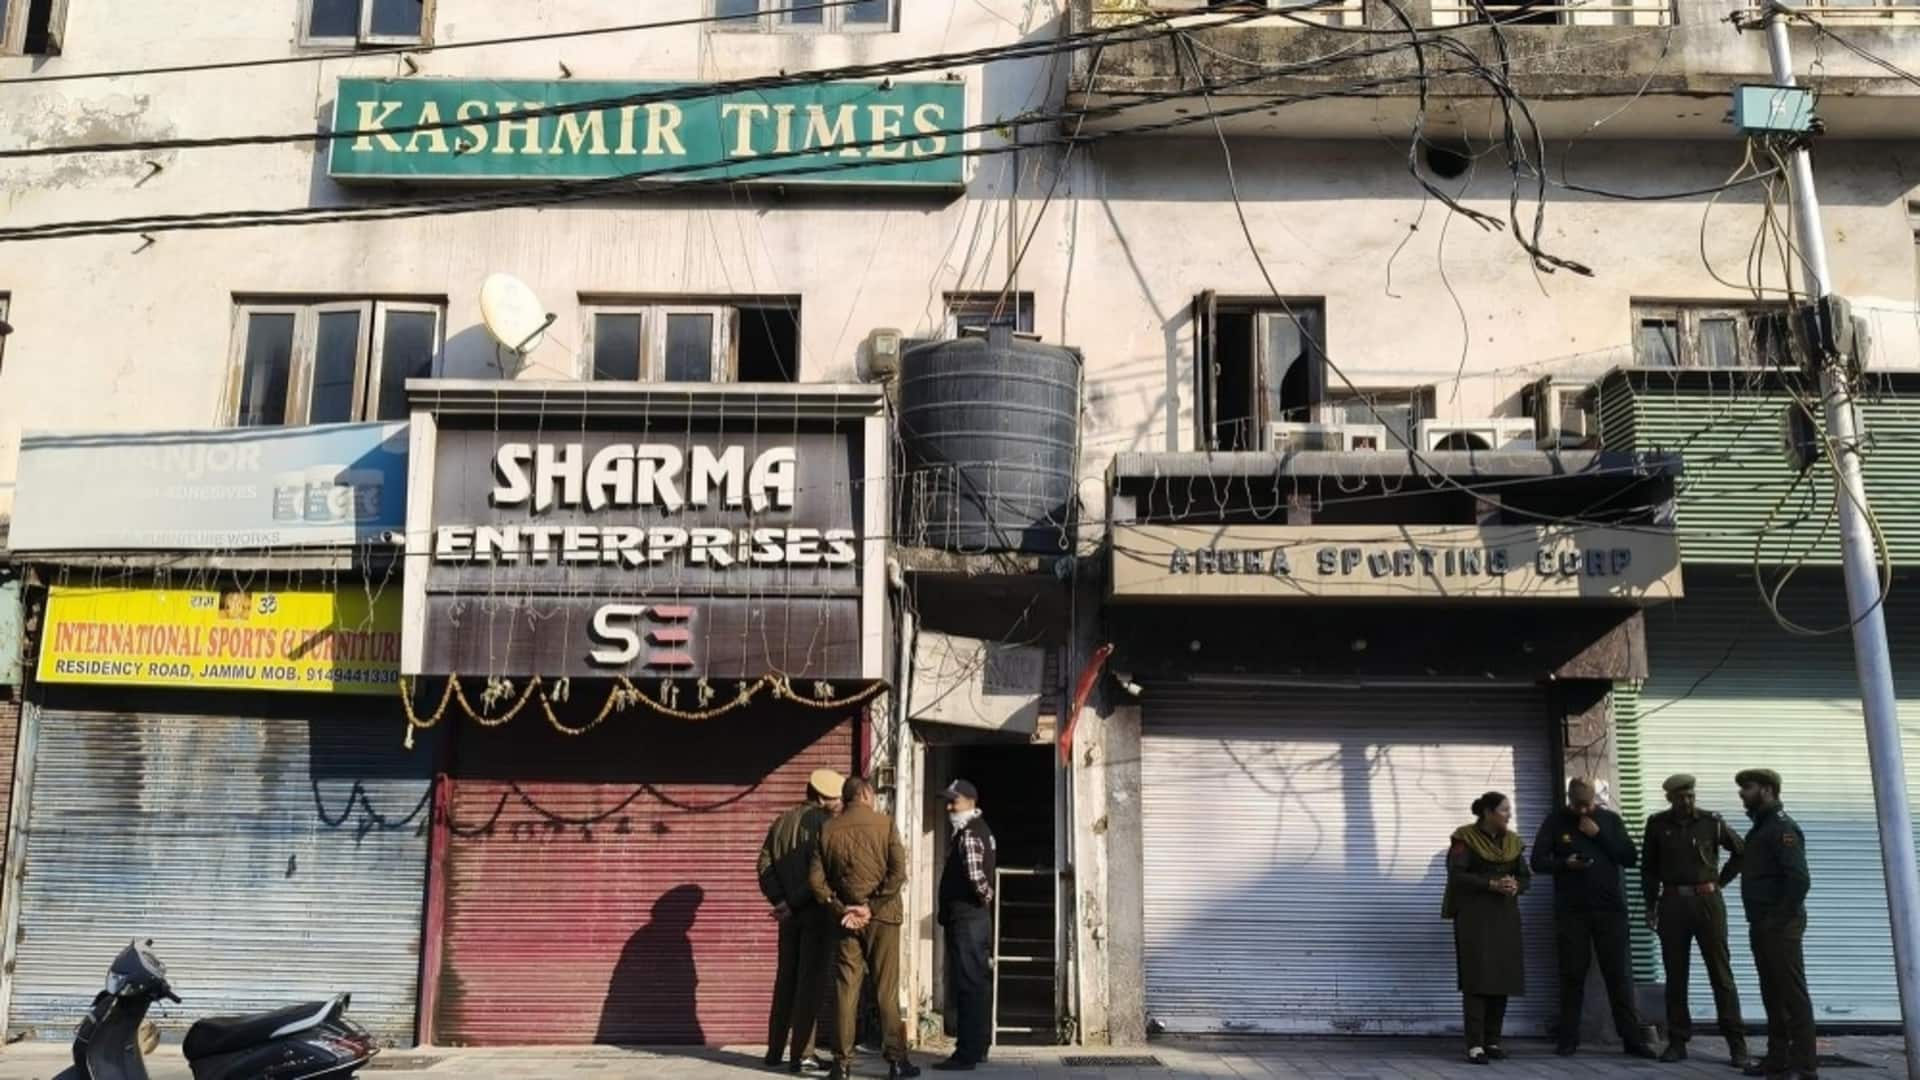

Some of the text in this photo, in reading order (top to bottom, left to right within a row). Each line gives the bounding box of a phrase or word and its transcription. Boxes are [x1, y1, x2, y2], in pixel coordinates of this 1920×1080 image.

[352, 99, 948, 160] KASHMIR TIMES
[493, 442, 798, 513] SHARMA
[436, 524, 858, 567] ENTERPRISES
[1317, 547, 1508, 578] SPORTING
[1535, 547, 1633, 577] CORP
[54, 622, 202, 656] INTERNATIONAL
[207, 626, 278, 659] SPORTS
[55, 659, 143, 676] RESIDENCY
[148, 662, 195, 679] ROAD,
[200, 663, 257, 680] JAMMU
[261, 665, 301, 681] MOB.
